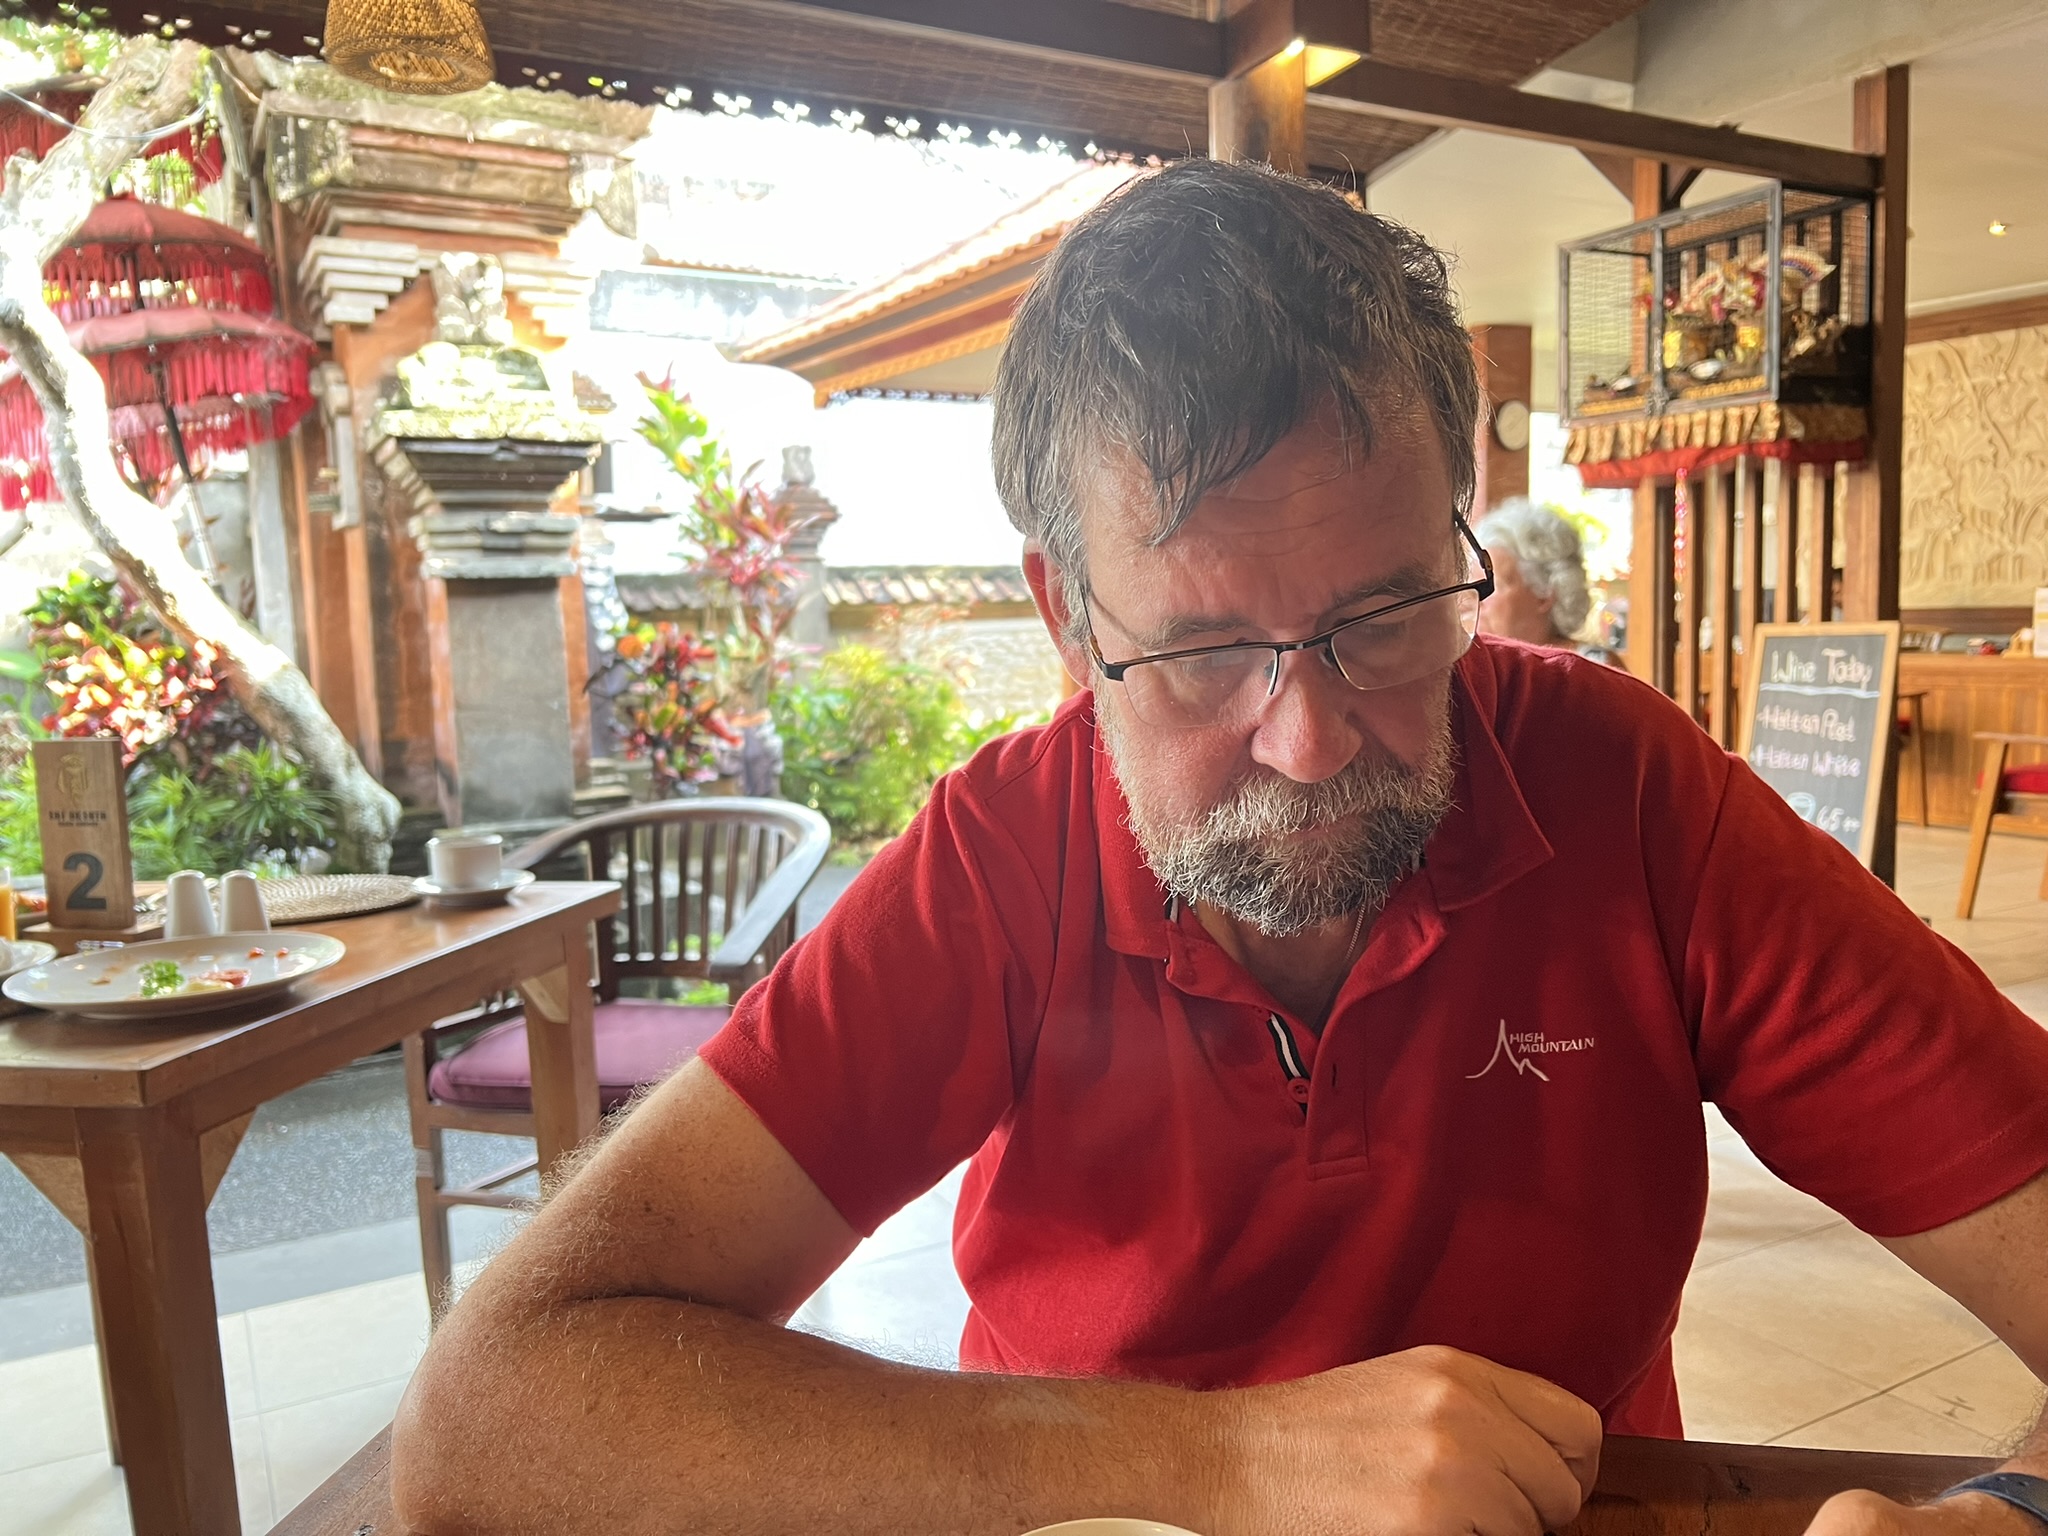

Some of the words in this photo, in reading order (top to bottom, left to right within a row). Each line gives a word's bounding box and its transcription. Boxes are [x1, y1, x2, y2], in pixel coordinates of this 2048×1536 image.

[1771, 650, 1816, 683] Wine
[1821, 647, 1873, 692] Today
[63, 852, 107, 910] 2
[1510, 1032, 1544, 1044] HIGH
[1518, 1037, 1595, 1054] MOUNTAIN
